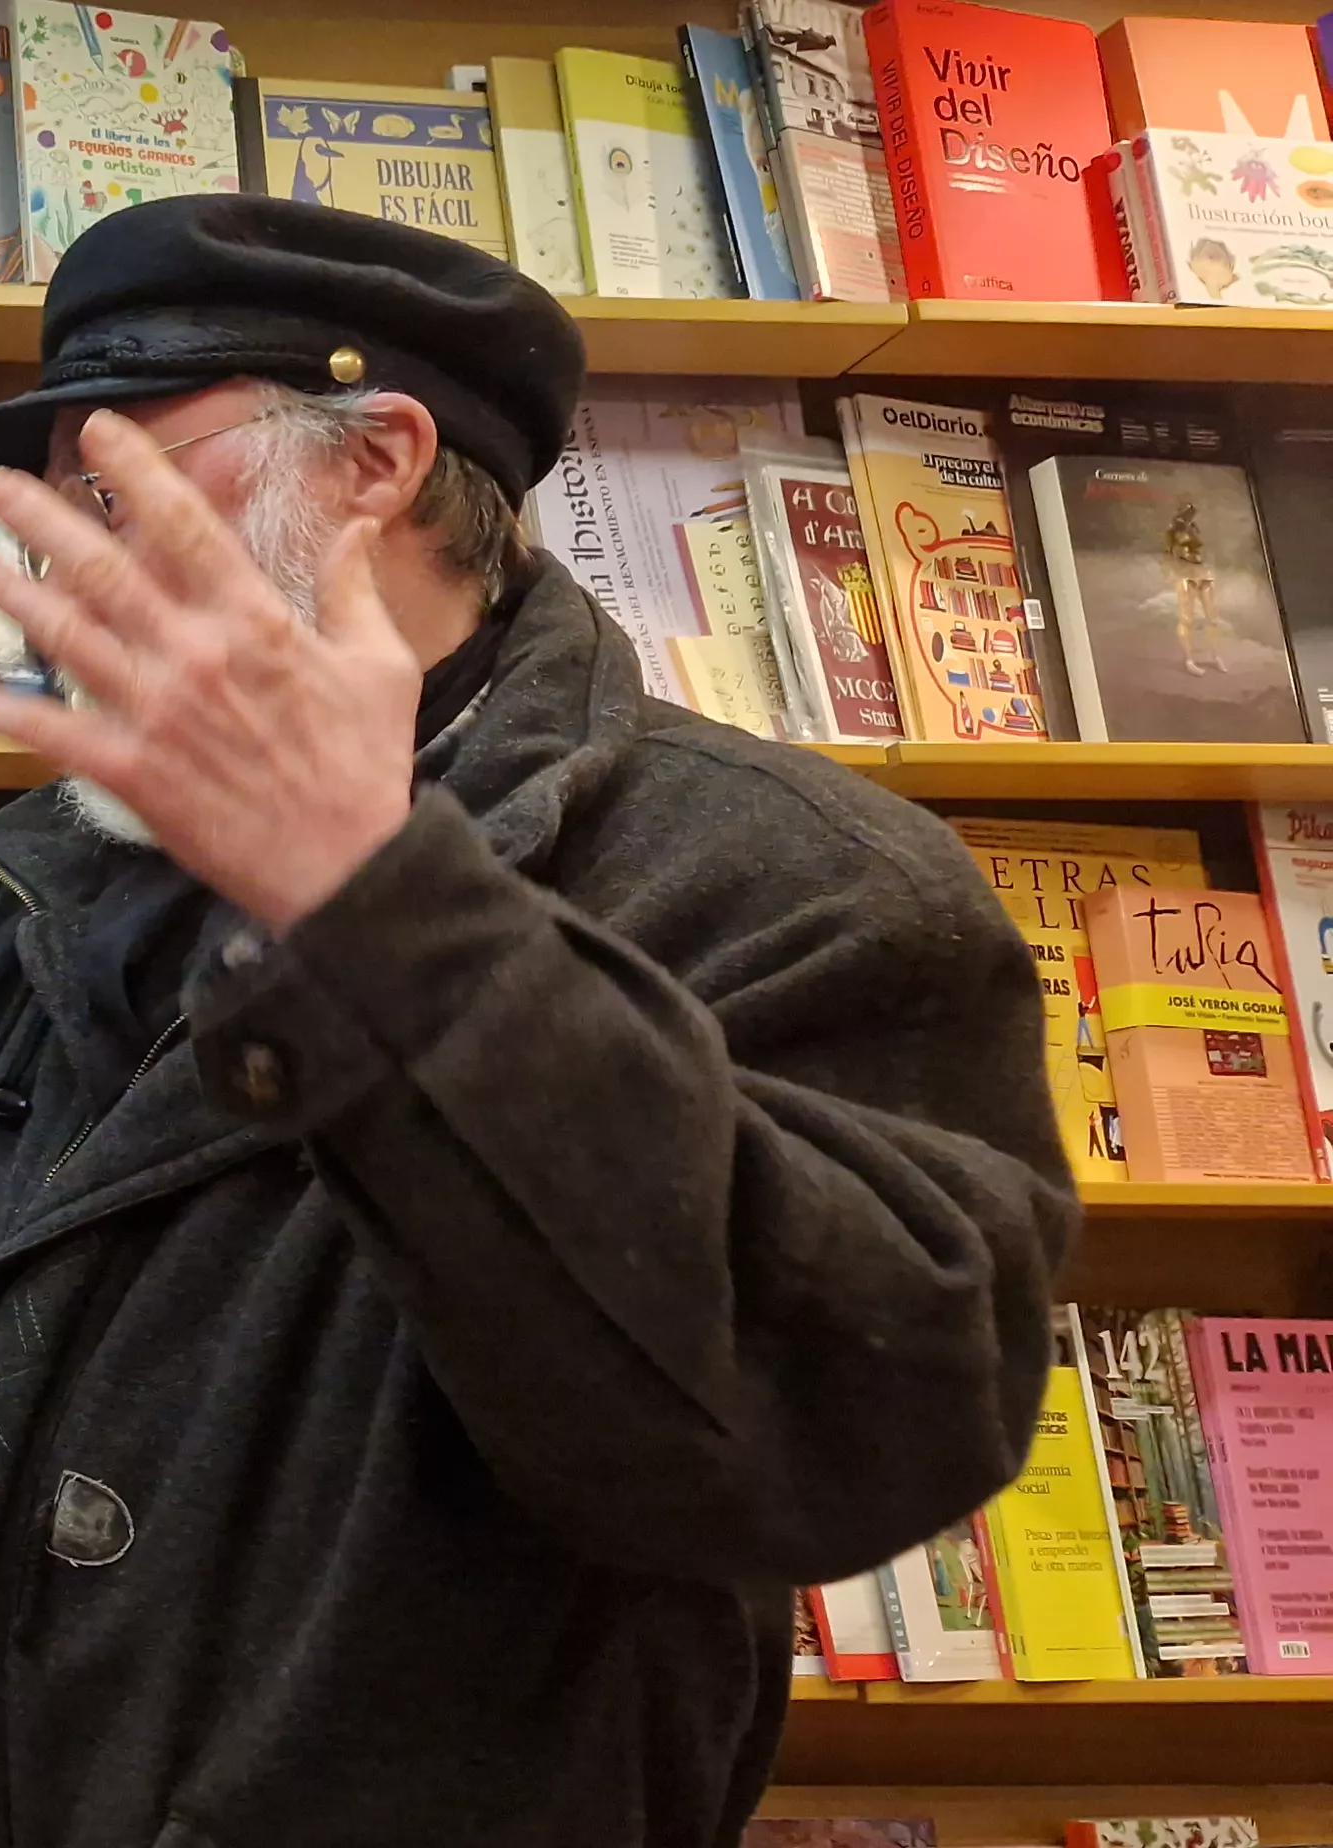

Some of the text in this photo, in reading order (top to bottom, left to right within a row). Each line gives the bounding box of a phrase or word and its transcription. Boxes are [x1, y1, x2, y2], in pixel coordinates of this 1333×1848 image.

[922, 45, 1012, 92] Vivir
[933, 87, 993, 127] del
[68, 139, 196, 167] PEQUEÑOS GRANDES
[104, 128, 132, 143] libro
[135, 134, 150, 146] de
[153, 135, 171, 149] los
[937, 126, 1082, 183] Diseño
[103, 160, 162, 178] artistas
[375, 158, 474, 192] DIBUJAR
[379, 192, 479, 228] ES FÁCIL
[897, 157, 926, 239] DISEÑO
[1187, 203, 1294, 228] Ilustración
[933, 456, 973, 473] precio
[940, 469, 955, 483] de
[599, 485, 635, 590] RENACIMIENTO
[1167, 994, 1196, 1009] JOSÉ
[1199, 997, 1240, 1012] VERÓN
[1097, 1329, 1167, 1381] 142
[1220, 1331, 1269, 1373] LA
[1016, 1480, 1051, 1495] social
